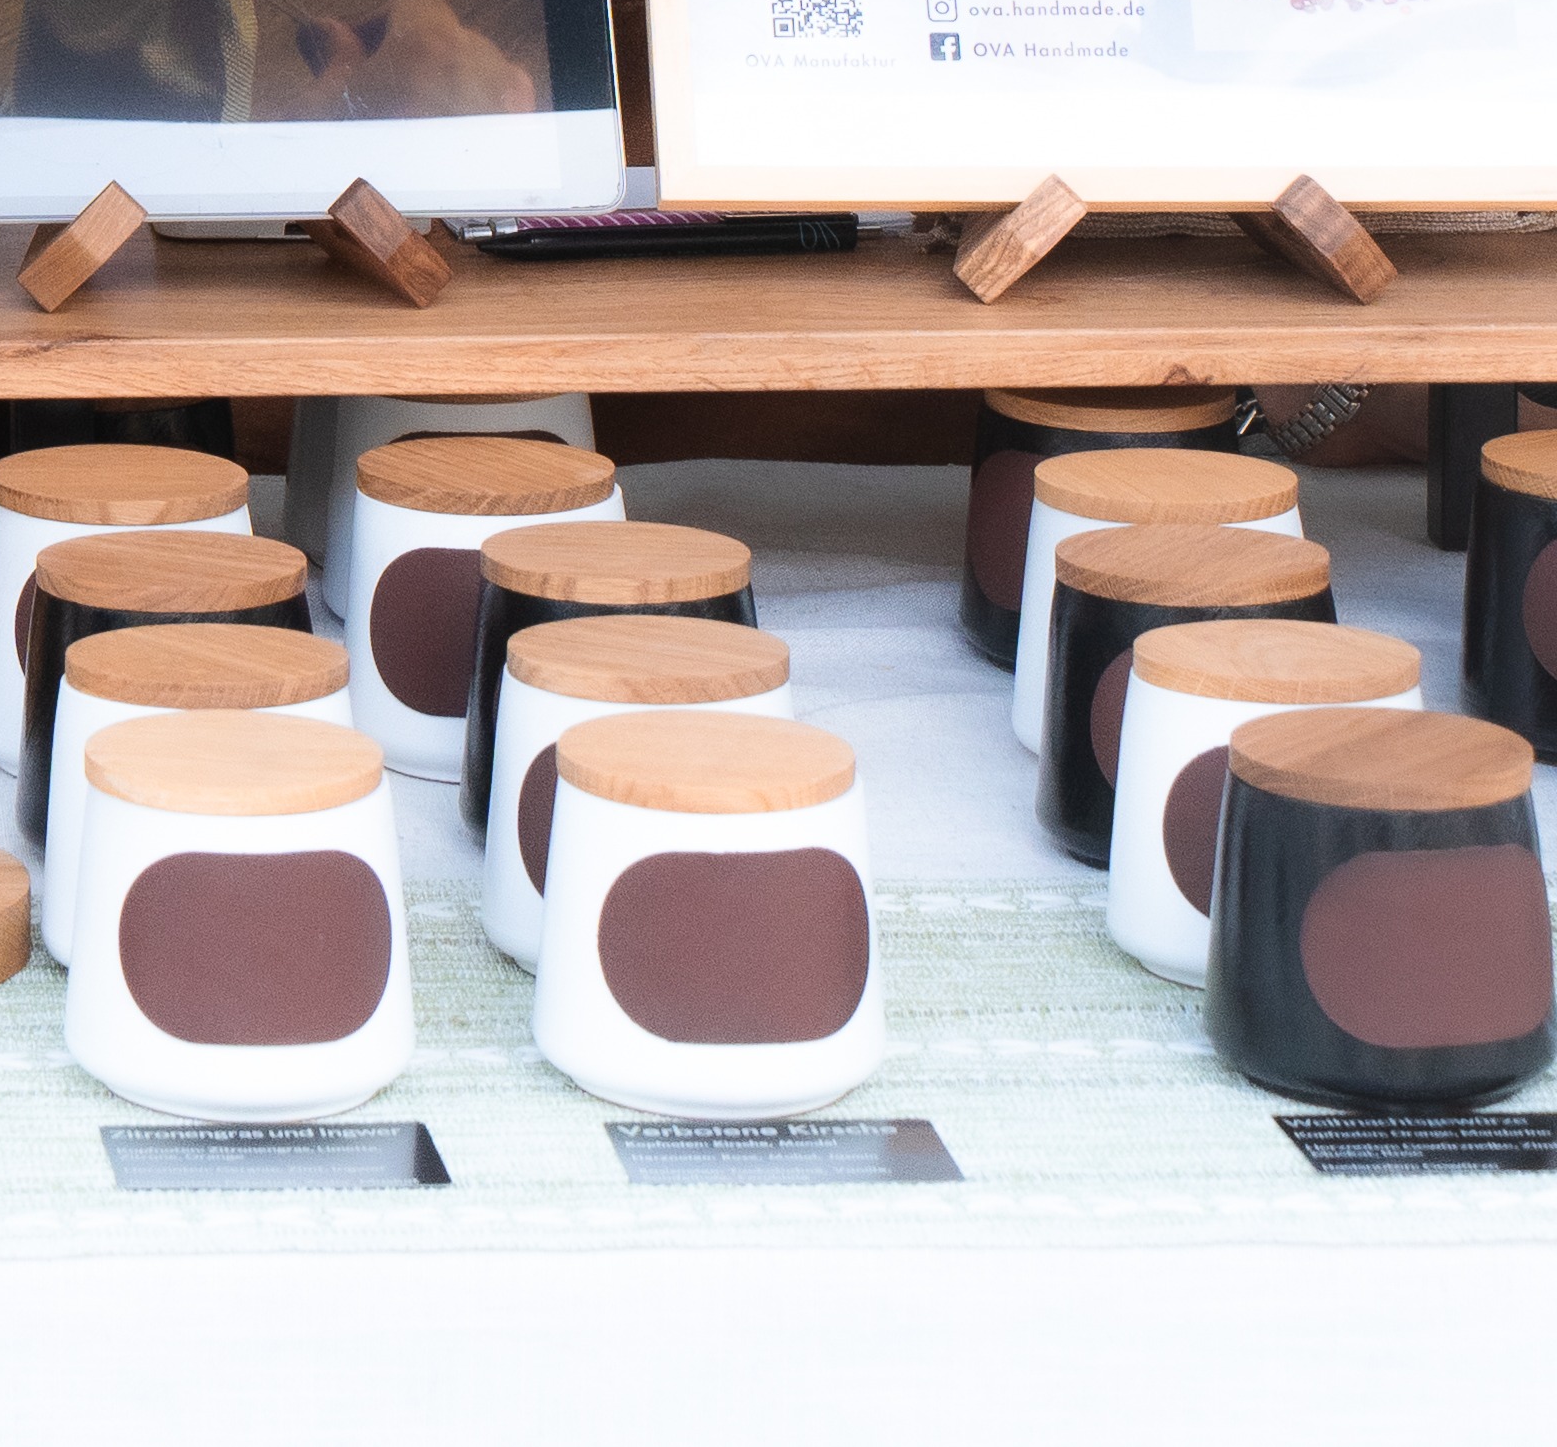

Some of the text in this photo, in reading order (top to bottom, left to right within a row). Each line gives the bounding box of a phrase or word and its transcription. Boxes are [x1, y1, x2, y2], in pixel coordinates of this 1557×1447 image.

[969, 0, 1145, 17] ova.handmade.de
[973, 42, 1129, 58] OVA Handmade
[745, 53, 897, 69] OVA Manufaktur
[268, 1126, 314, 1138] und
[319, 1126, 401, 1140] Ingwer
